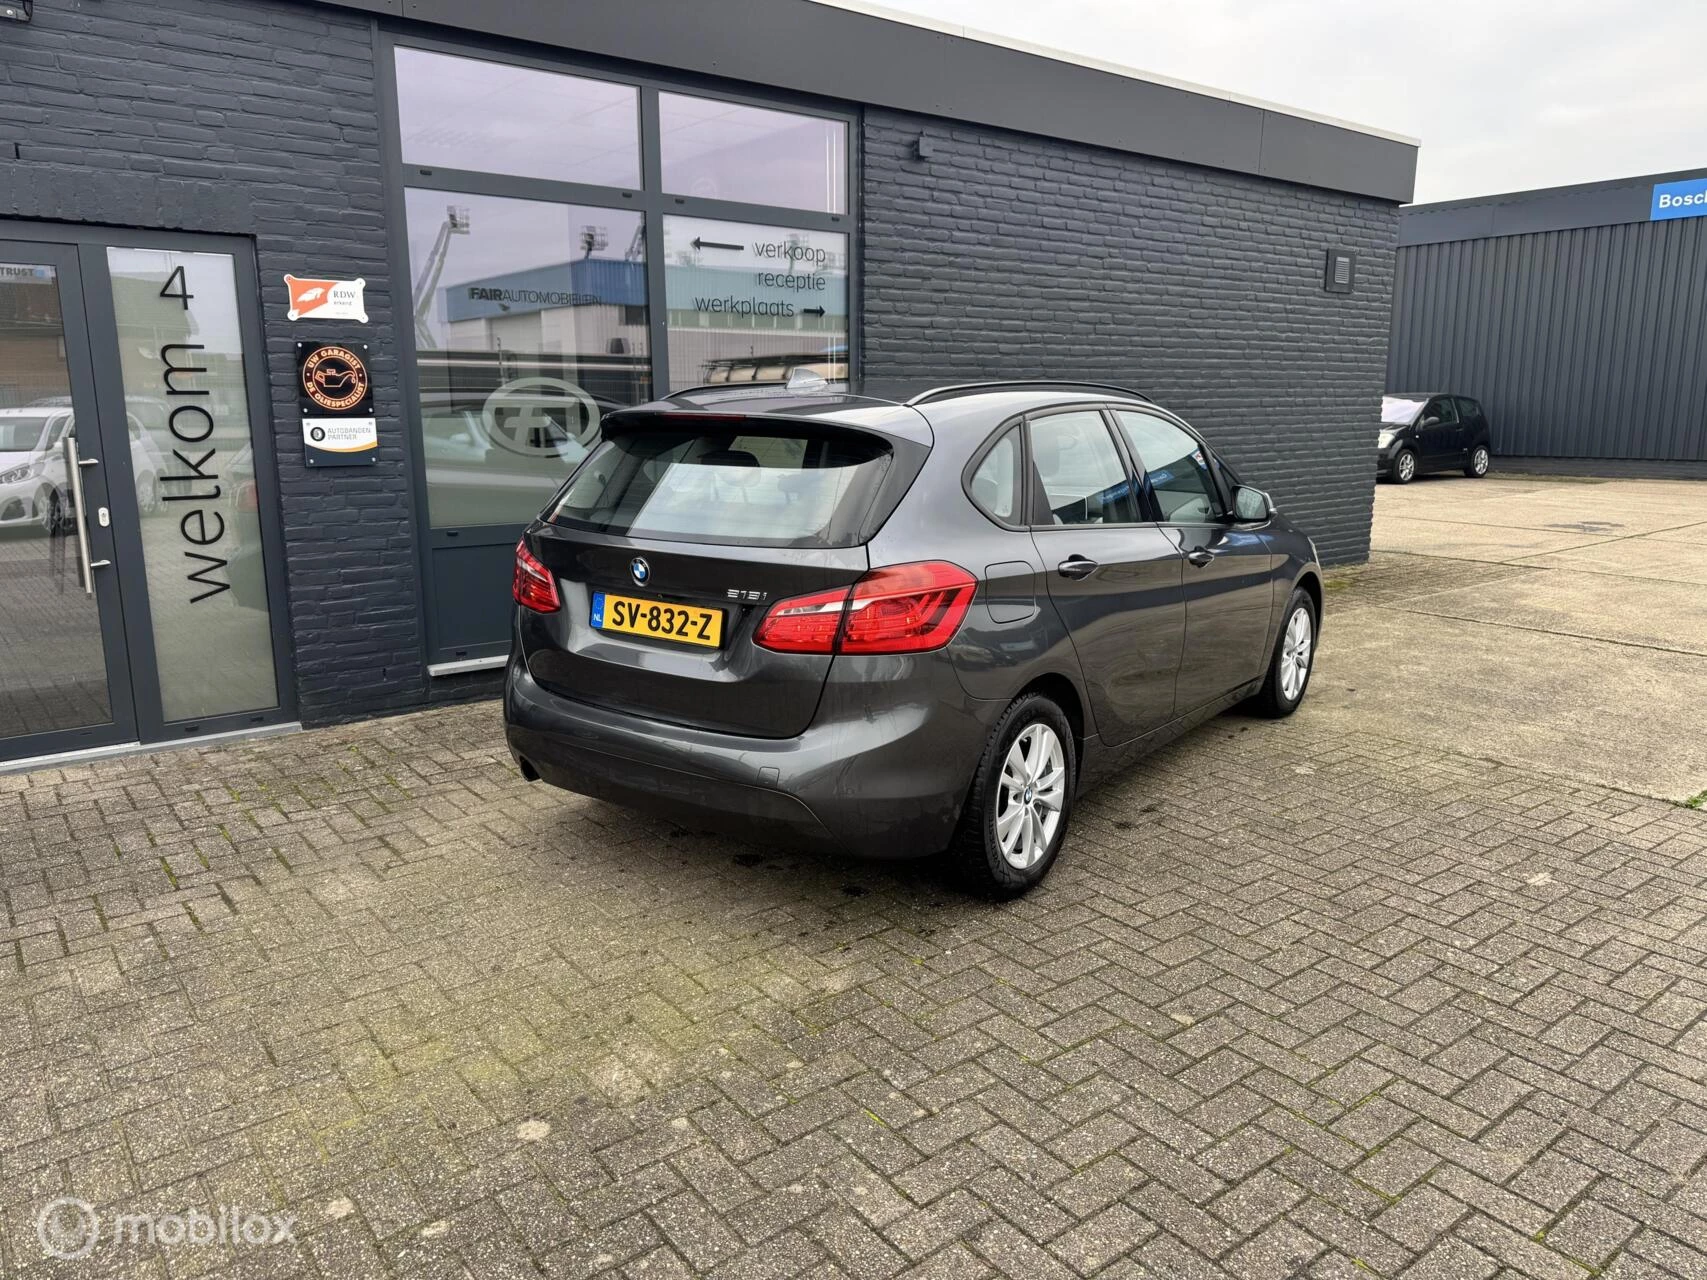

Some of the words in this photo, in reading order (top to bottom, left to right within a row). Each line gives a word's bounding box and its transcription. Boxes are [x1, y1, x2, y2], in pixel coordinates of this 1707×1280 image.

[1659, 189, 1707, 208] Bosc
[755, 241, 826, 263] verkoop
[159, 265, 194, 311] 4
[758, 272, 826, 292] receptie
[333, 290, 356, 298] RDW
[695, 295, 795, 318] werkplaats
[307, 354, 320, 368] UW
[321, 349, 360, 369] GARAGIST
[306, 381, 316, 393] DE
[314, 382, 365, 408] OLIESPECIALIST
[159, 344, 231, 604] welkom
[593, 613, 602, 623] NL
[612, 601, 713, 641] SV-832-Z
